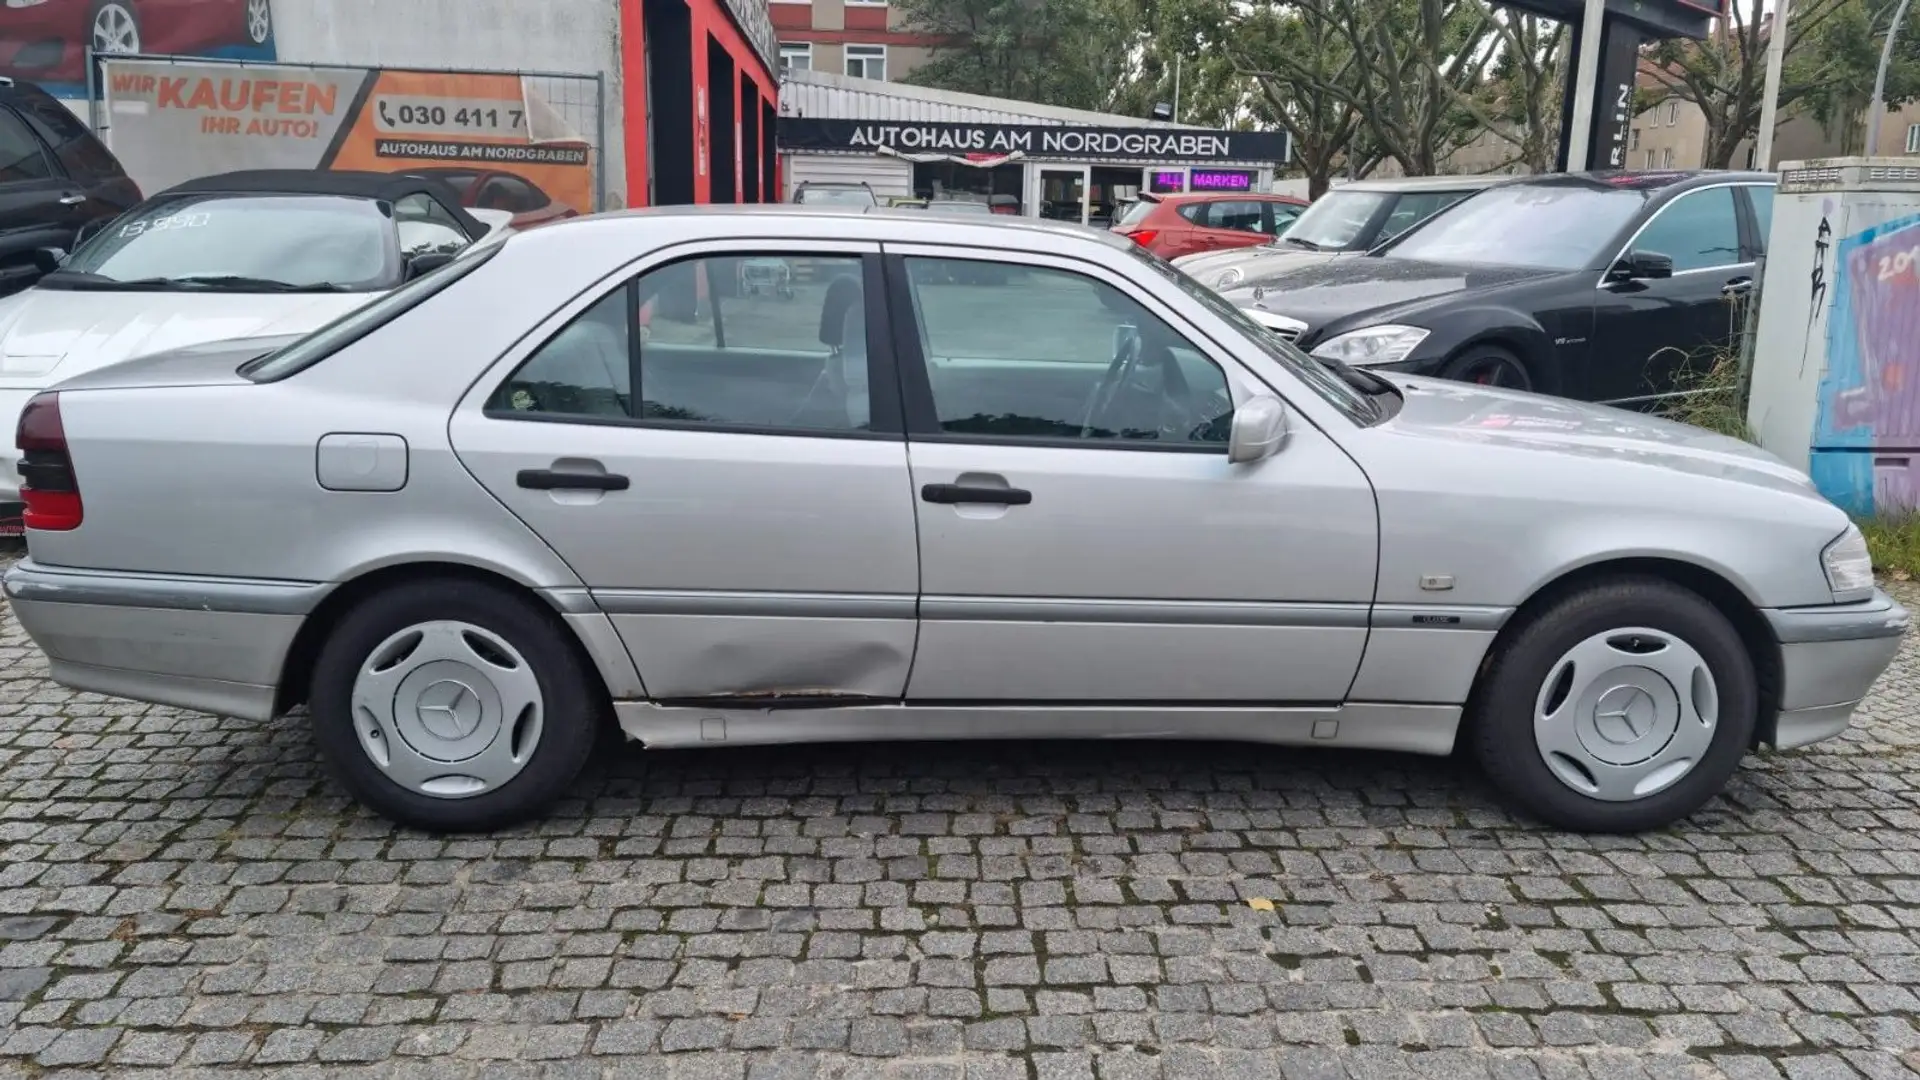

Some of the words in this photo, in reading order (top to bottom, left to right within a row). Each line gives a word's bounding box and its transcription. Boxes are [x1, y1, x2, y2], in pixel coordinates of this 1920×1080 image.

[112, 74, 156, 94] WIR
[157, 76, 338, 115] KAUFEN
[201, 116, 240, 135] IHR
[246, 118, 319, 138] AUTO!
[399, 105, 446, 126] 030
[454, 108, 498, 128] 411
[508, 110, 527, 129] 7
[1610, 84, 1629, 166] RLIN
[379, 141, 458, 157] AUTOHAUS
[460, 147, 482, 158] AM
[484, 148, 584, 162] NORDGRABEN
[850, 126, 985, 149] AUTOHAUS
[990, 130, 1032, 150] AM
[1043, 132, 1229, 155] NORDGRABEN
[1157, 172, 1184, 185] ALL
[1193, 174, 1249, 187] MARKEN
